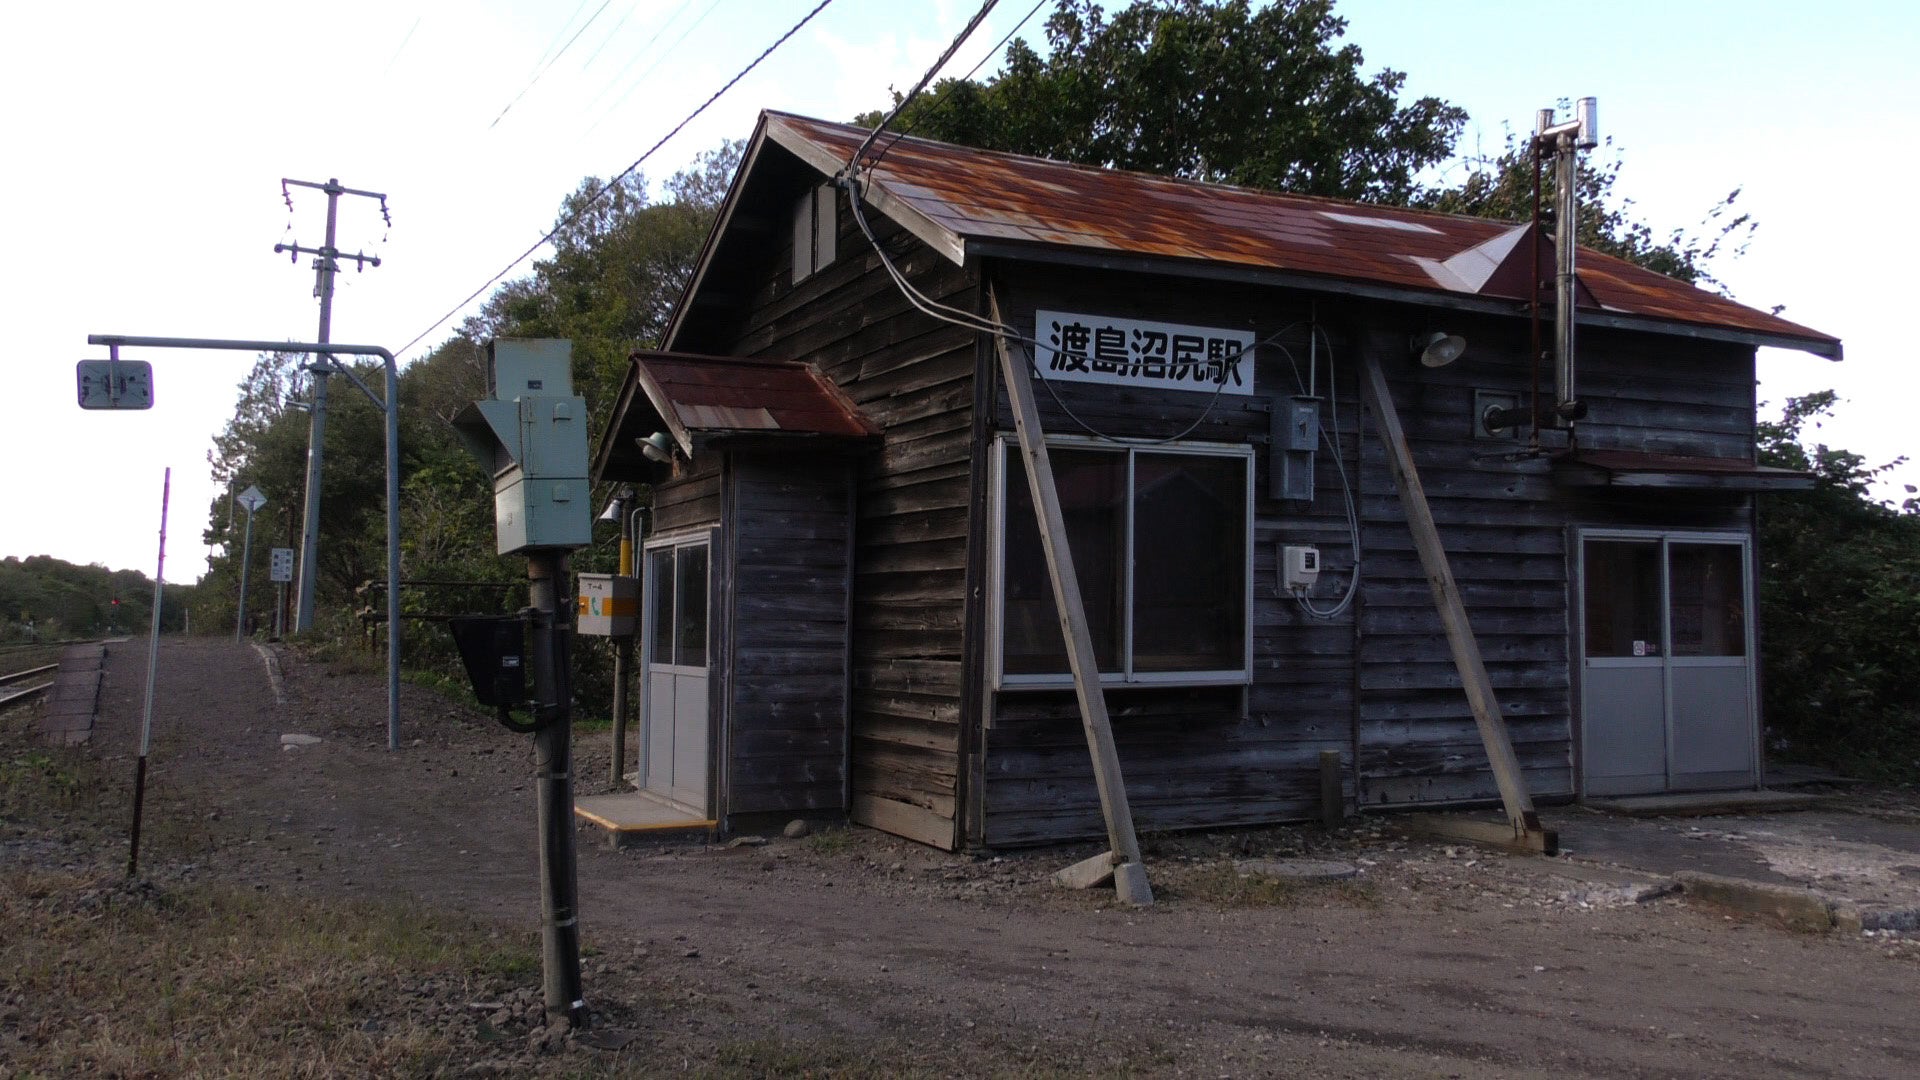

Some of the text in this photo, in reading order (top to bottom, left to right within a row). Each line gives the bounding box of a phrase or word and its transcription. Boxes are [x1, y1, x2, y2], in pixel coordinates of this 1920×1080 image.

[1050, 320, 1242, 386] 渡島沼尻駅
